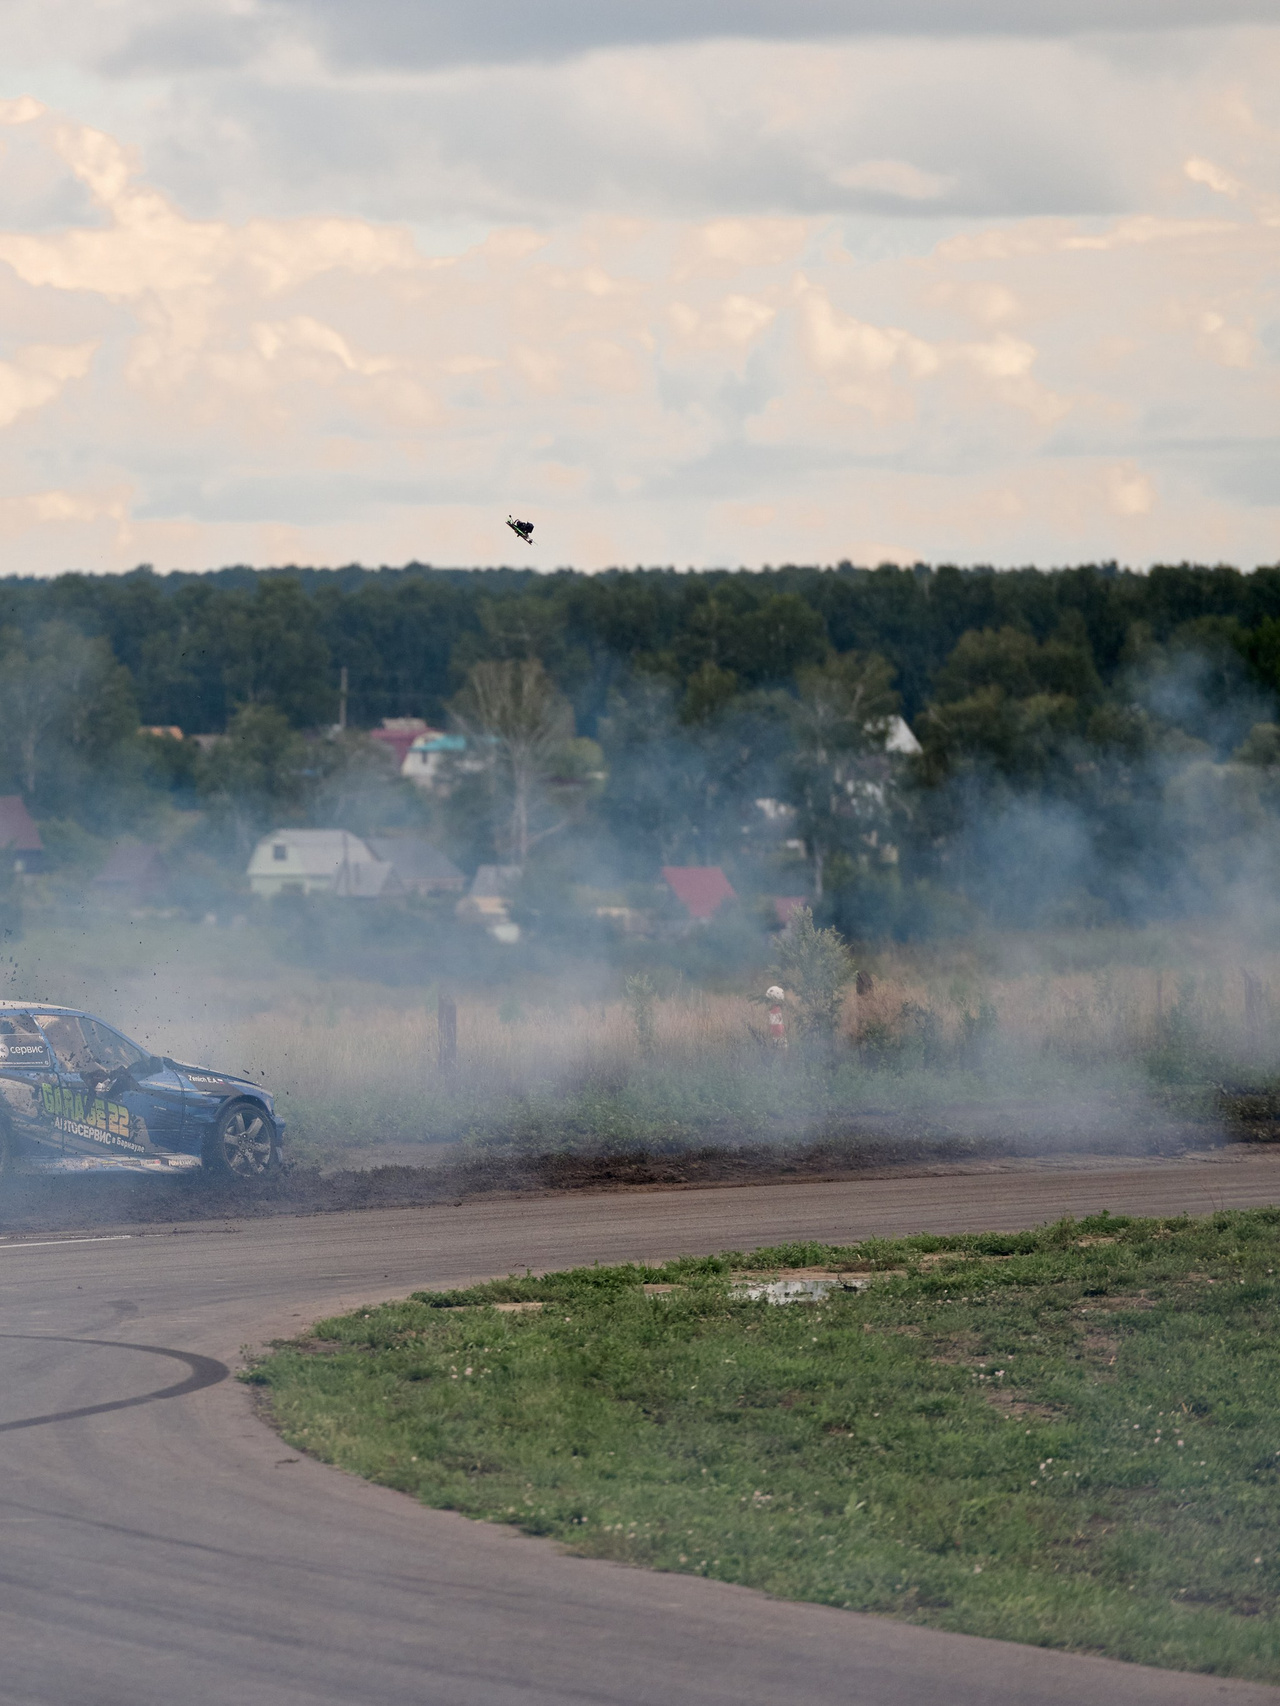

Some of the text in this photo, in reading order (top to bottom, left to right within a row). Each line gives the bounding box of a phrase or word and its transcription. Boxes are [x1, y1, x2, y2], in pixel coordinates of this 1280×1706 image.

[10, 1045, 44, 1056] сервис
[54, 1116, 112, 1145] АВТОСЕРВИС
[116, 1136, 145, 1153] Барнауле
[107, 1101, 130, 1138] 22
